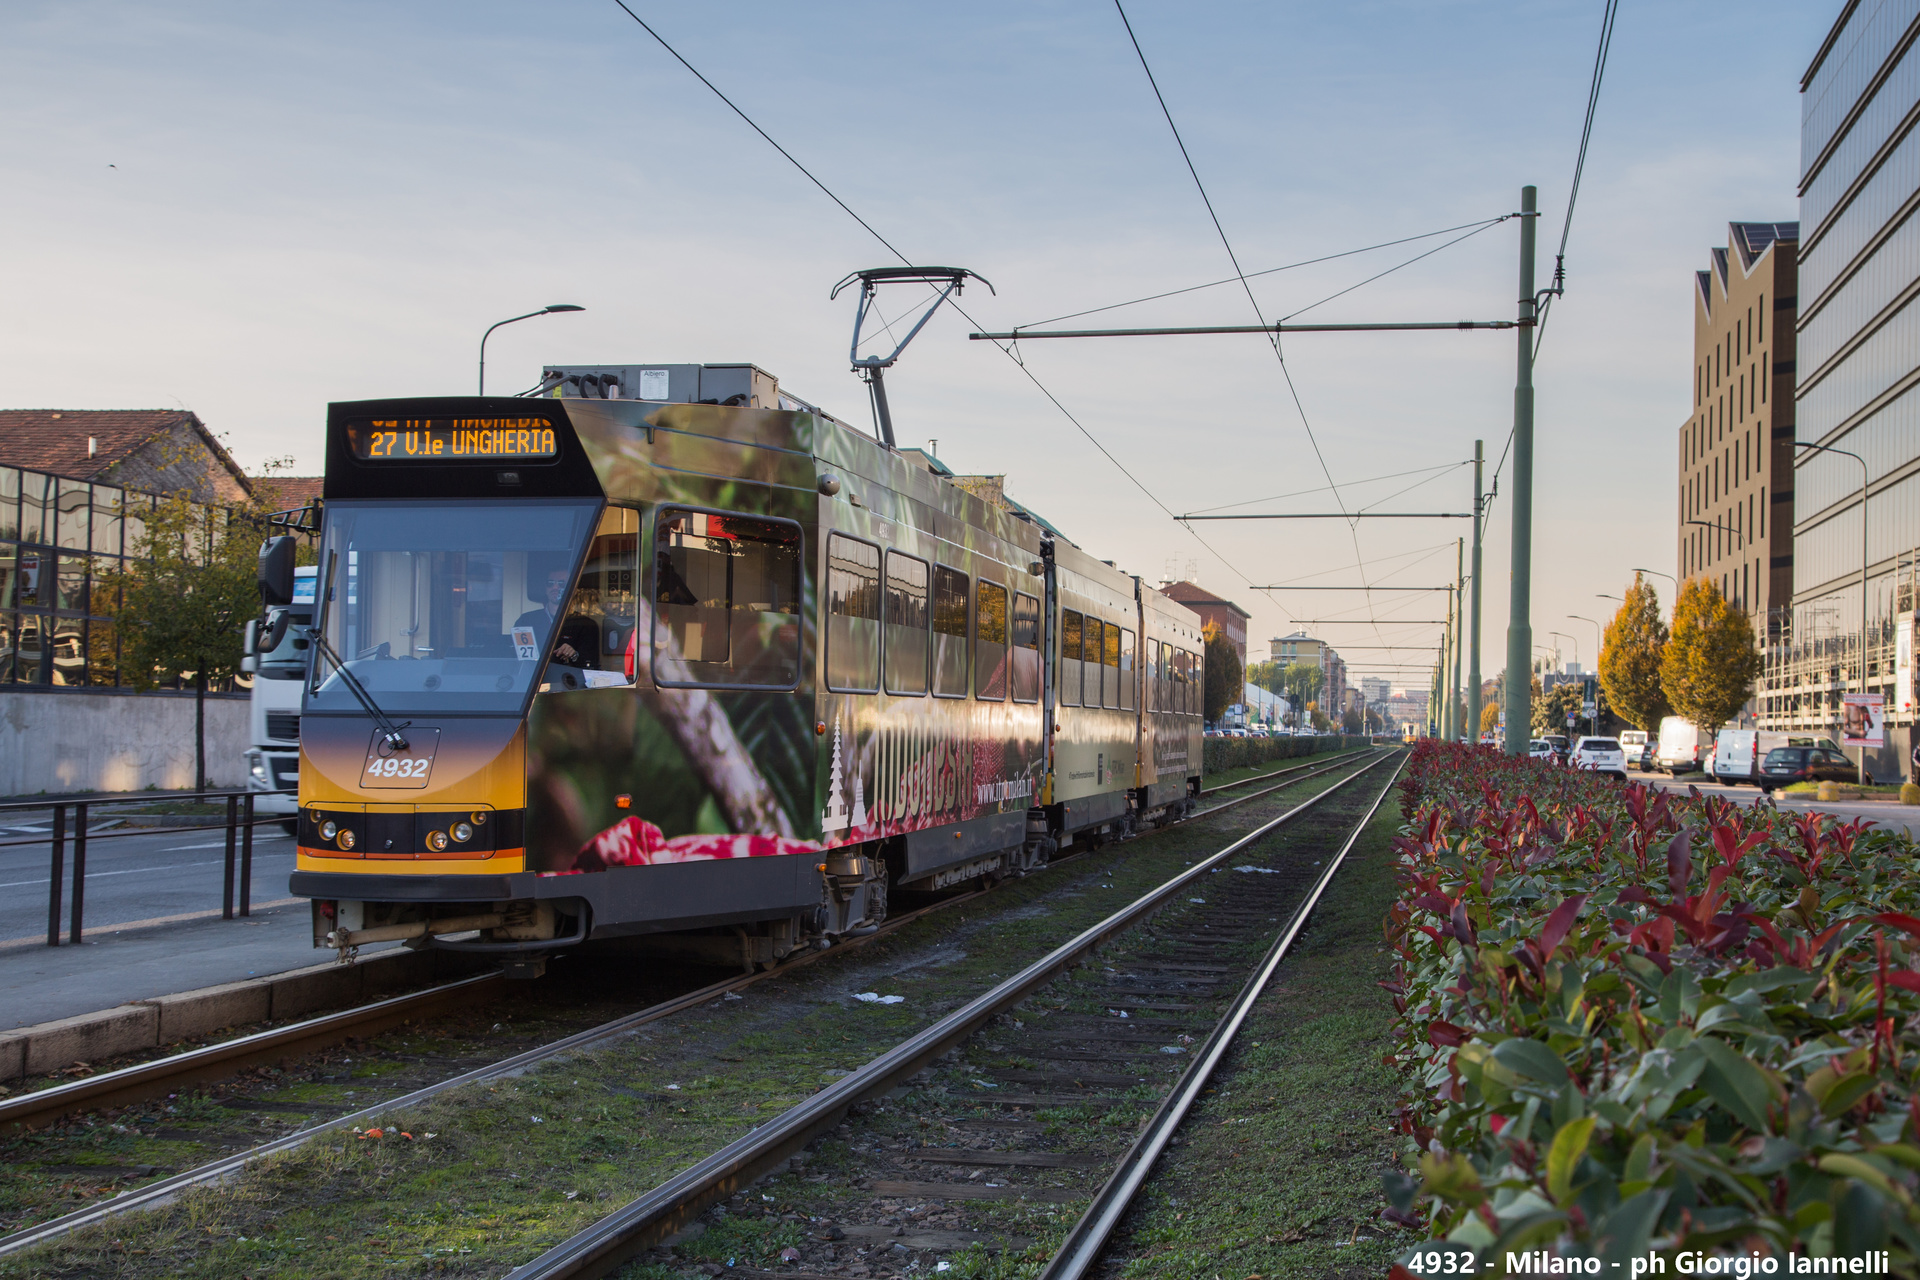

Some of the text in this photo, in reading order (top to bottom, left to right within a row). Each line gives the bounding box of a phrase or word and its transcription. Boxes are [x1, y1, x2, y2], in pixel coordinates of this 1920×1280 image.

[370, 431, 397, 456] 27
[452, 429, 554, 454] UNGHERIA
[520, 633, 529, 645] 6
[520, 646, 534, 658] 27
[368, 758, 428, 778] 4932
